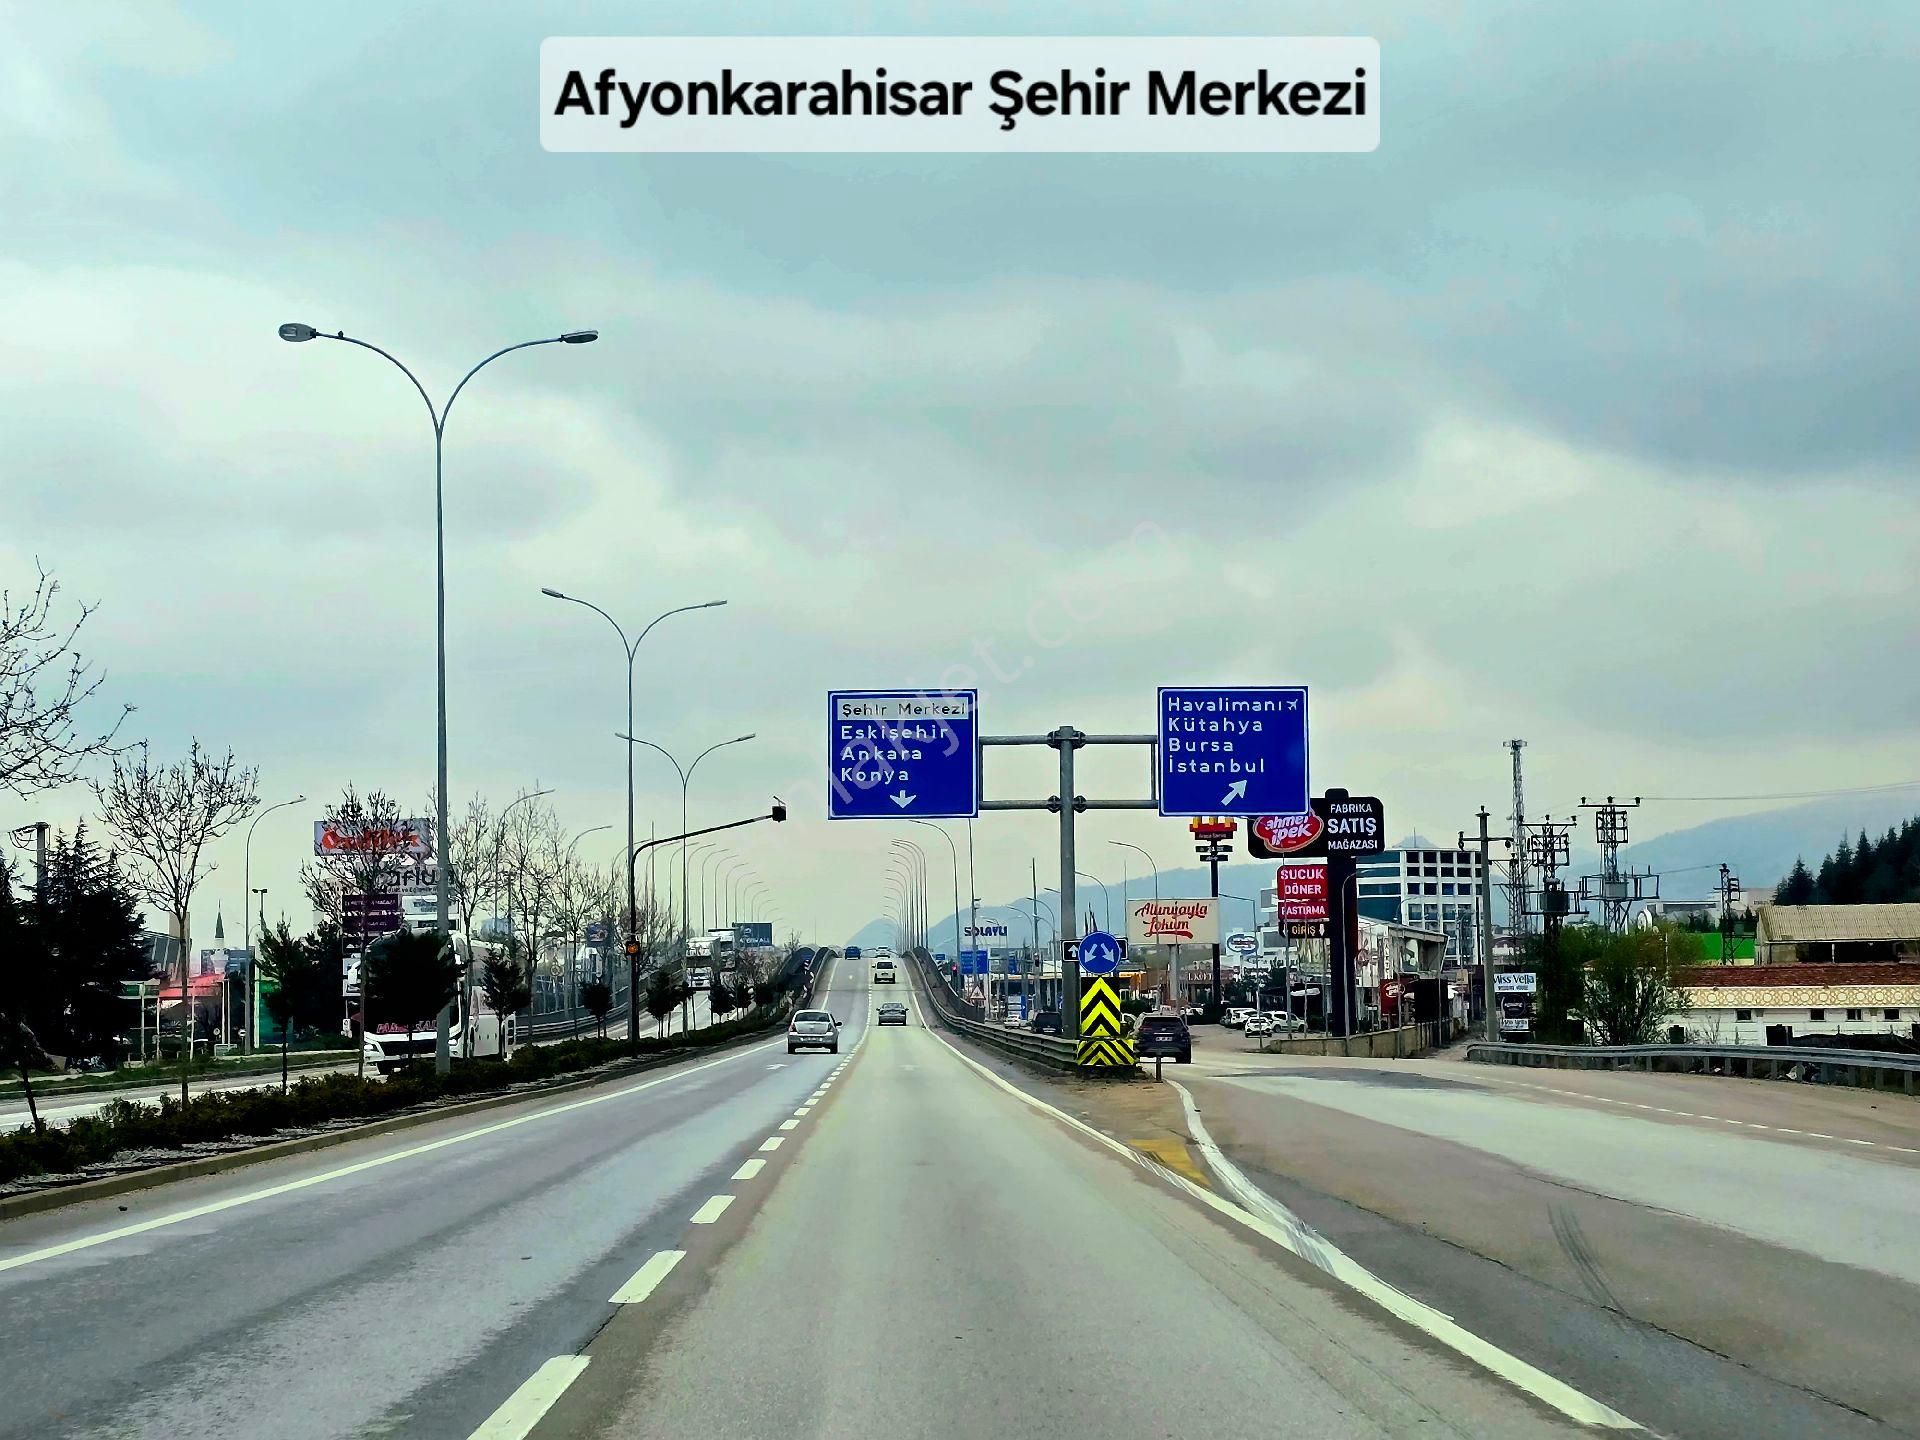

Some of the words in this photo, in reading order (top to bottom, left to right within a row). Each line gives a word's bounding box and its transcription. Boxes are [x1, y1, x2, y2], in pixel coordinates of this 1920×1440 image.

[842, 702, 887, 717] Şehir
[898, 702, 964, 716] Merkezi
[1168, 697, 1281, 712] Havalimanı
[841, 724, 949, 741] Eskişehir
[1168, 717, 1263, 735] Kütahya
[1168, 738, 1234, 753] Bursa
[841, 746, 922, 761] Ankara
[1169, 755, 1264, 773] İstanbul
[841, 767, 909, 784] Konya
[1328, 817, 1377, 836] SATIŞ
[1328, 838, 1378, 850] MAĞAZASI
[1280, 868, 1325, 880] SUCUK
[1285, 882, 1322, 895] DÖNER
